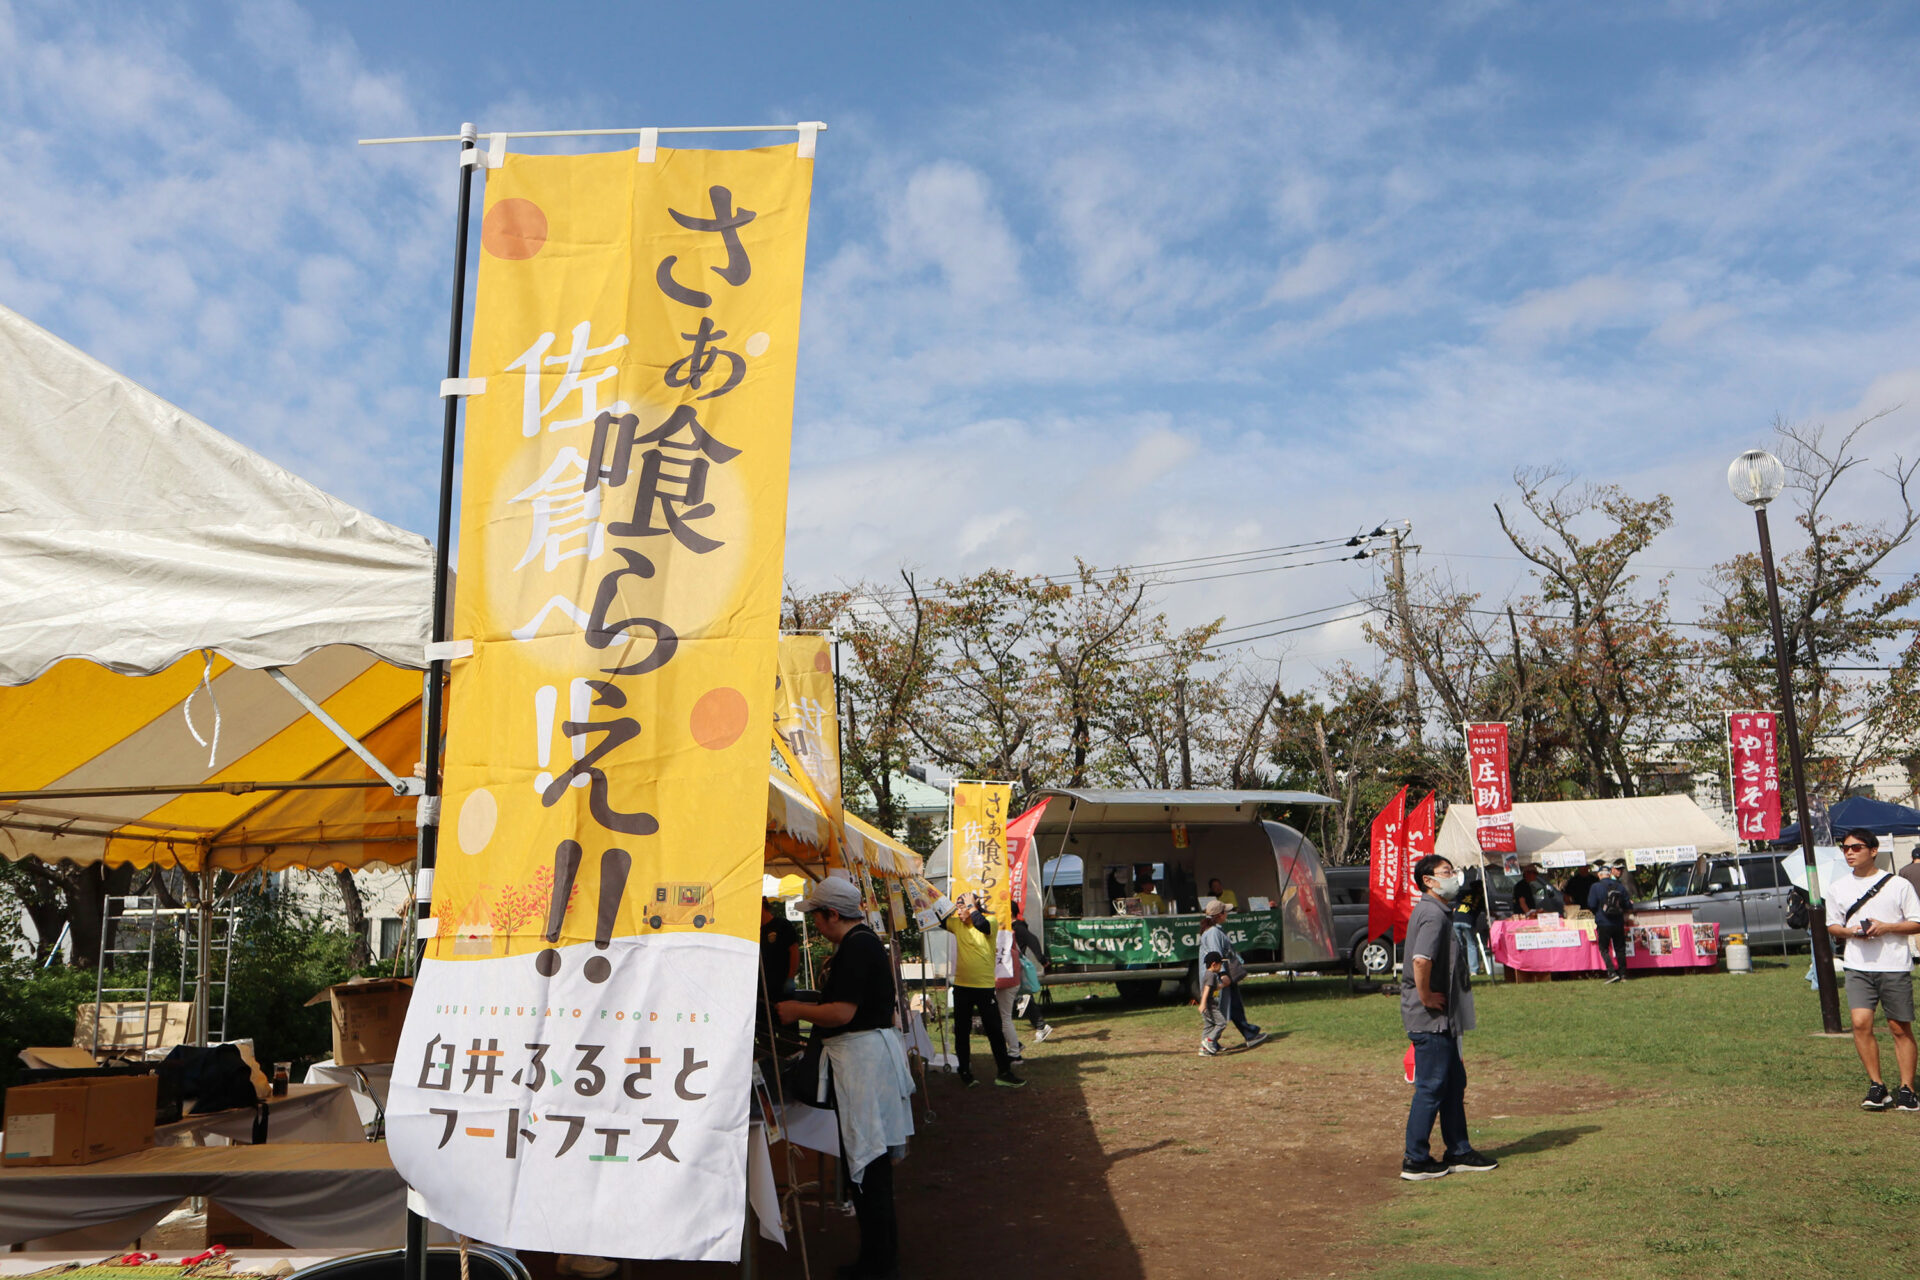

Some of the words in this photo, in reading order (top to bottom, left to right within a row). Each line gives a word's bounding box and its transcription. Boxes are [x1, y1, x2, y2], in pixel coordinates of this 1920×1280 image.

[1476, 757, 1500, 810] 庄助
[1738, 734, 1767, 833] やきそば
[436, 1004, 468, 1015] USUI
[479, 1006, 582, 1018] FURUSATO
[600, 1009, 659, 1022] FOOD
[676, 1012, 710, 1023] FES
[417, 1032, 708, 1101] 臼井ふるさと
[428, 1107, 681, 1163] フードフェス
